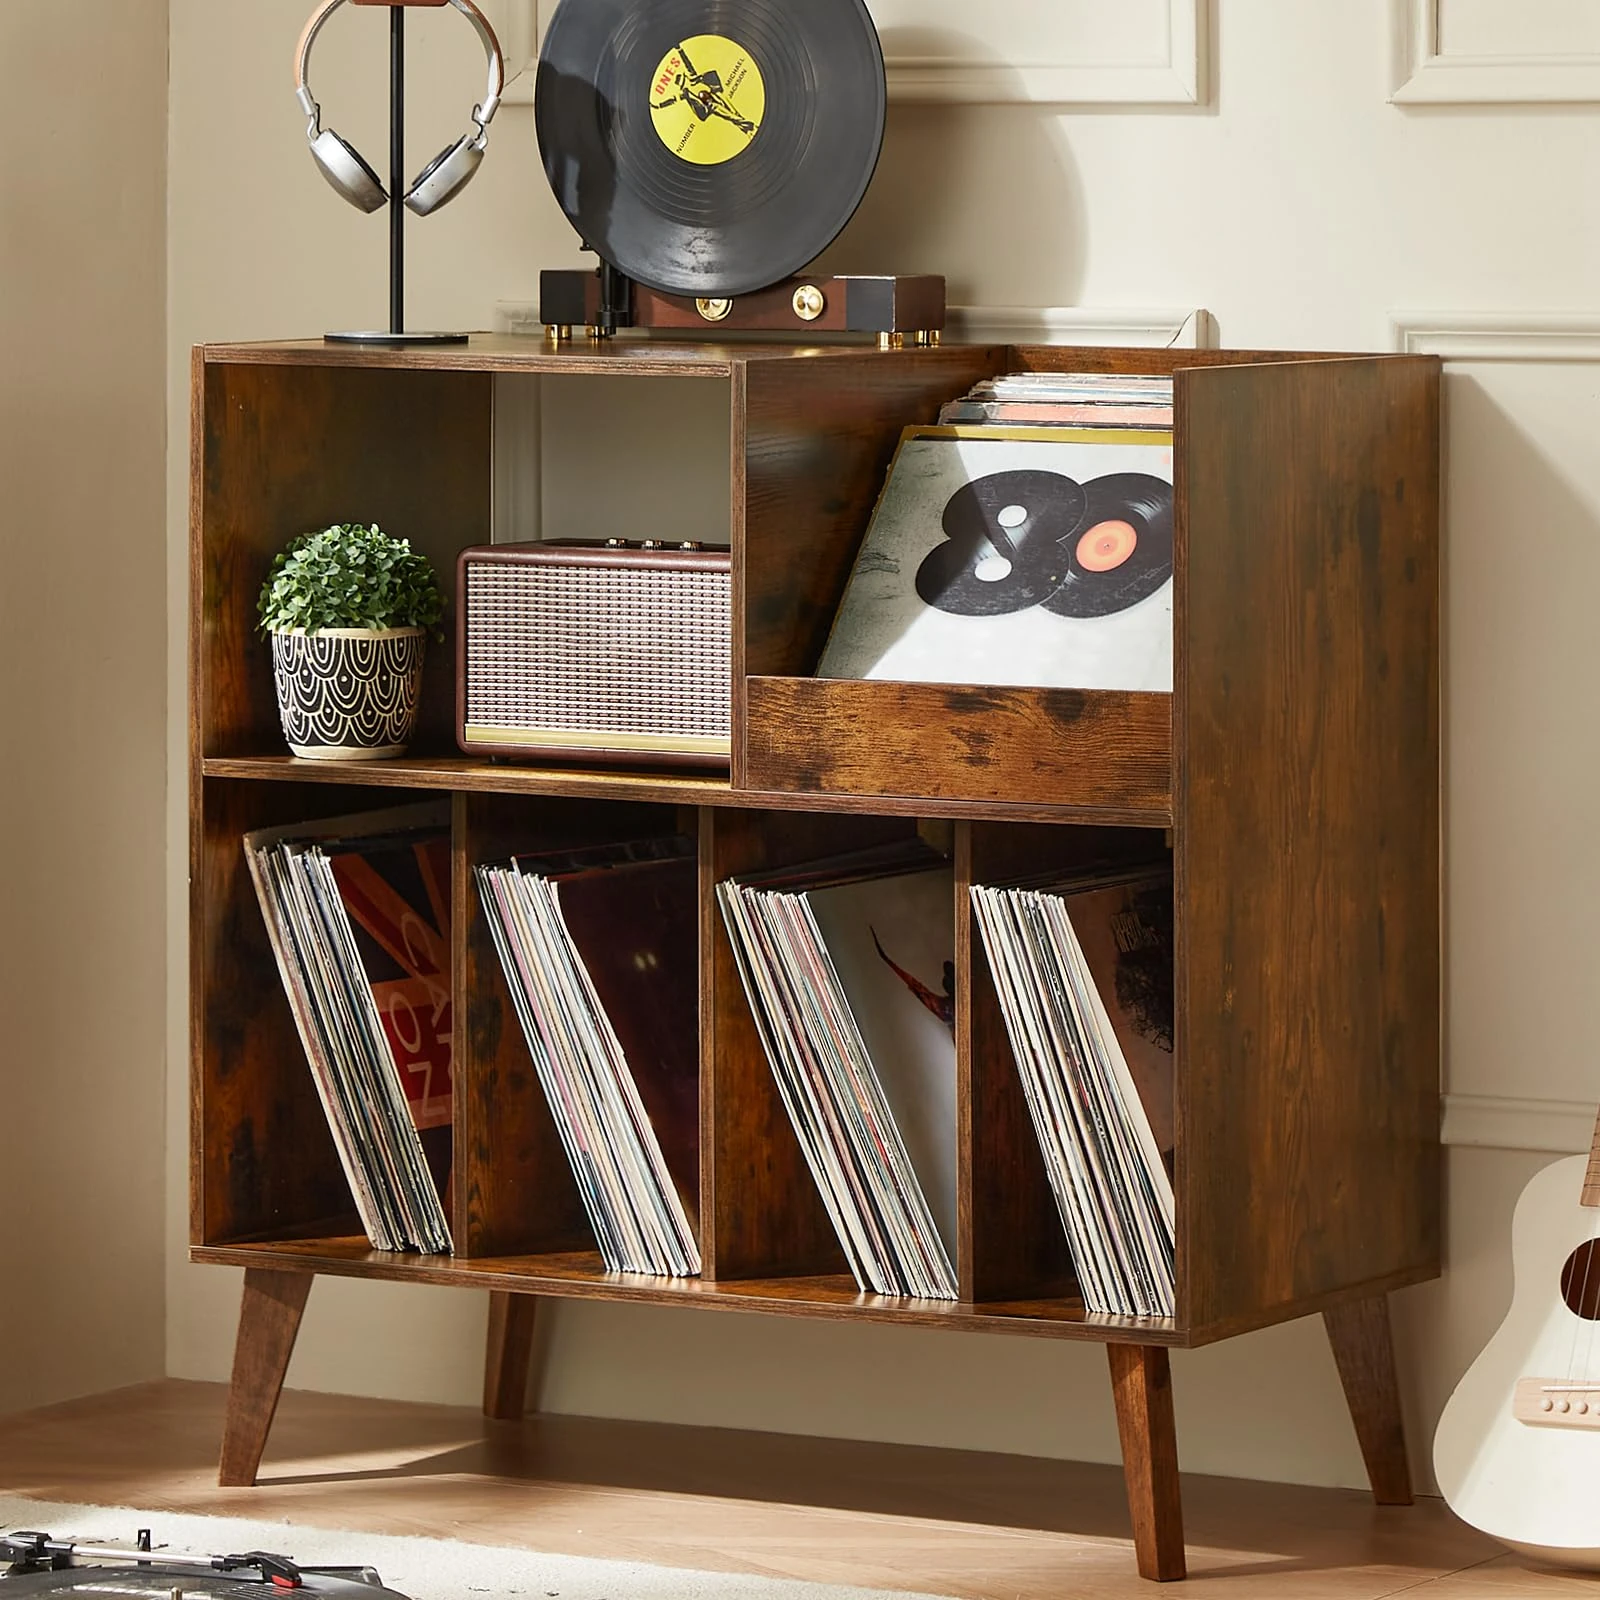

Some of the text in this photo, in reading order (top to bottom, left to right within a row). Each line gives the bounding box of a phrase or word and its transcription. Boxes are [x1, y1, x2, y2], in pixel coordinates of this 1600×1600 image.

[655, 57, 681, 95] ONES
[726, 58, 745, 86] MICHAEL
[729, 69, 747, 98] JACKSON
[676, 123, 695, 153] NUMBER
